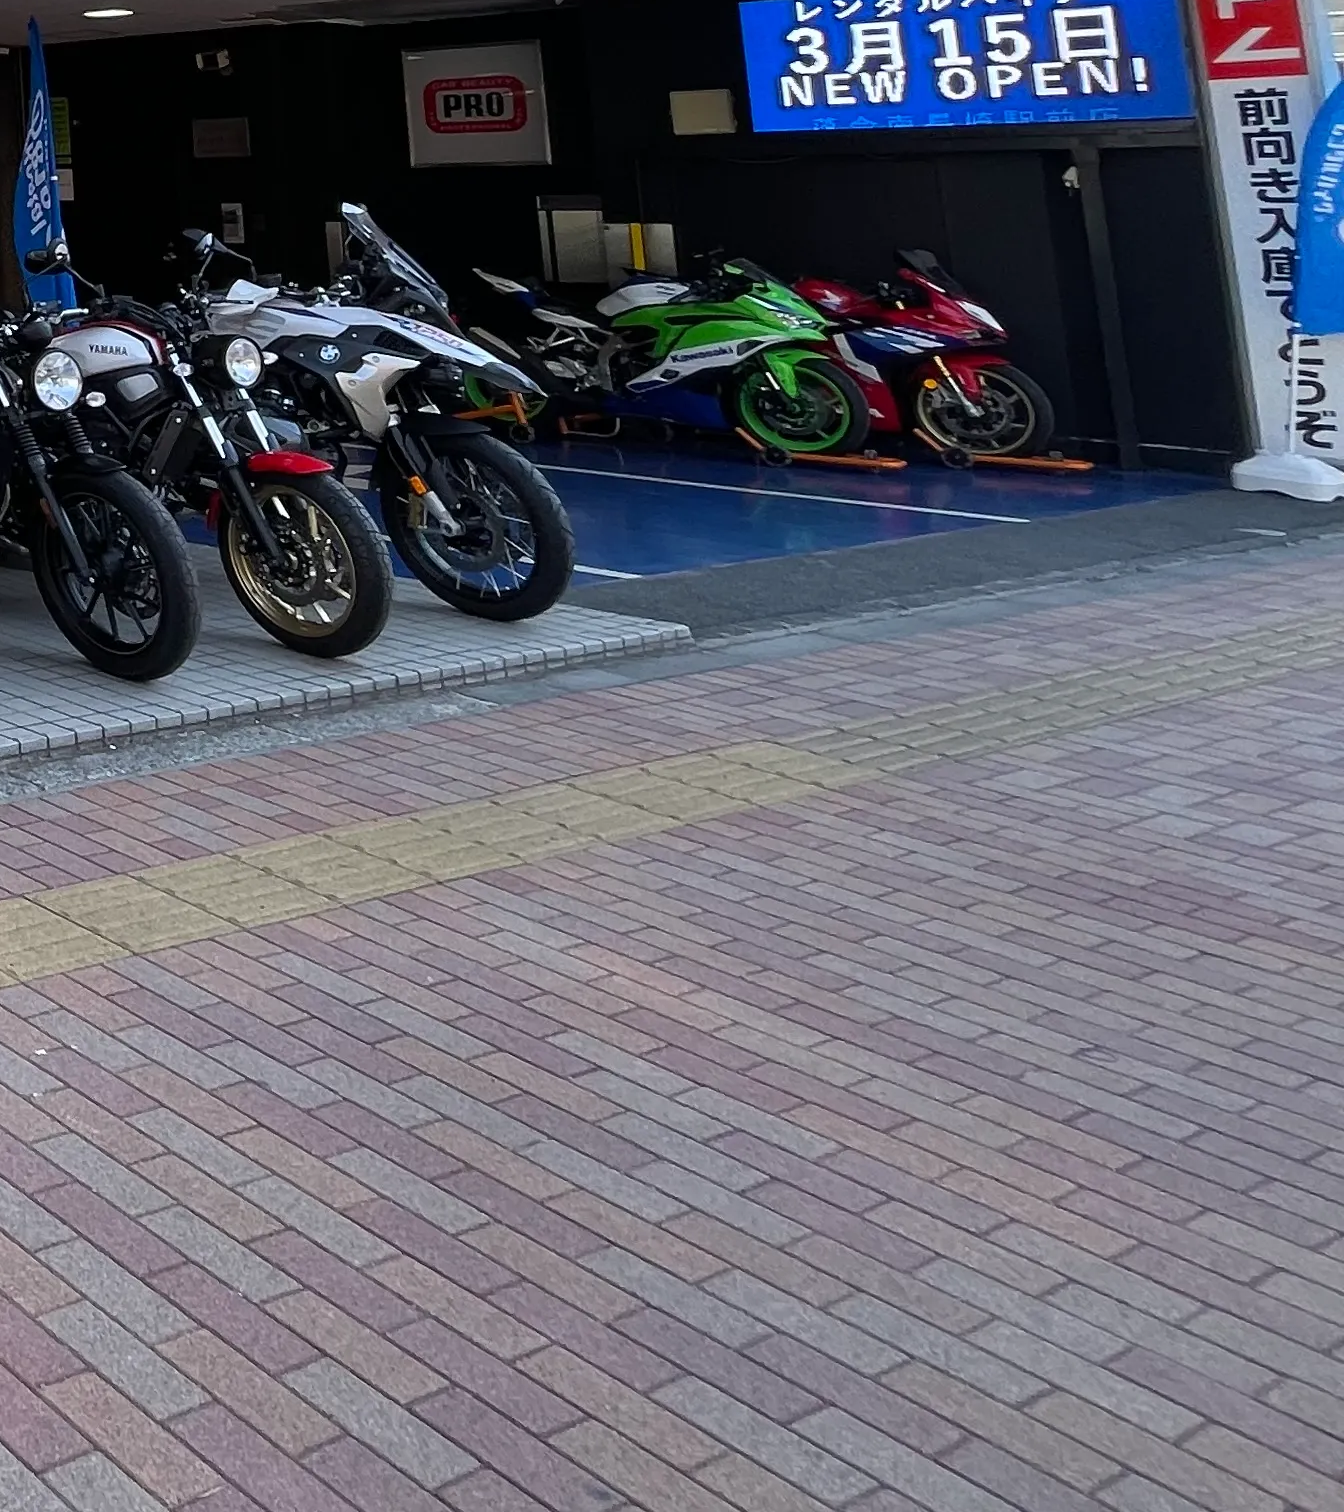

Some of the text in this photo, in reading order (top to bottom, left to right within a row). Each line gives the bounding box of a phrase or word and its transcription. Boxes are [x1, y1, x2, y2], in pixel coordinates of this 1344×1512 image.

[785, 4, 1119, 76] 3月15日
[779, 56, 1150, 108] NEW OPEN!
[443, 92, 505, 119] PRO
[87, 343, 129, 357] YAMAHA
[670, 345, 734, 364] Kawasaki
